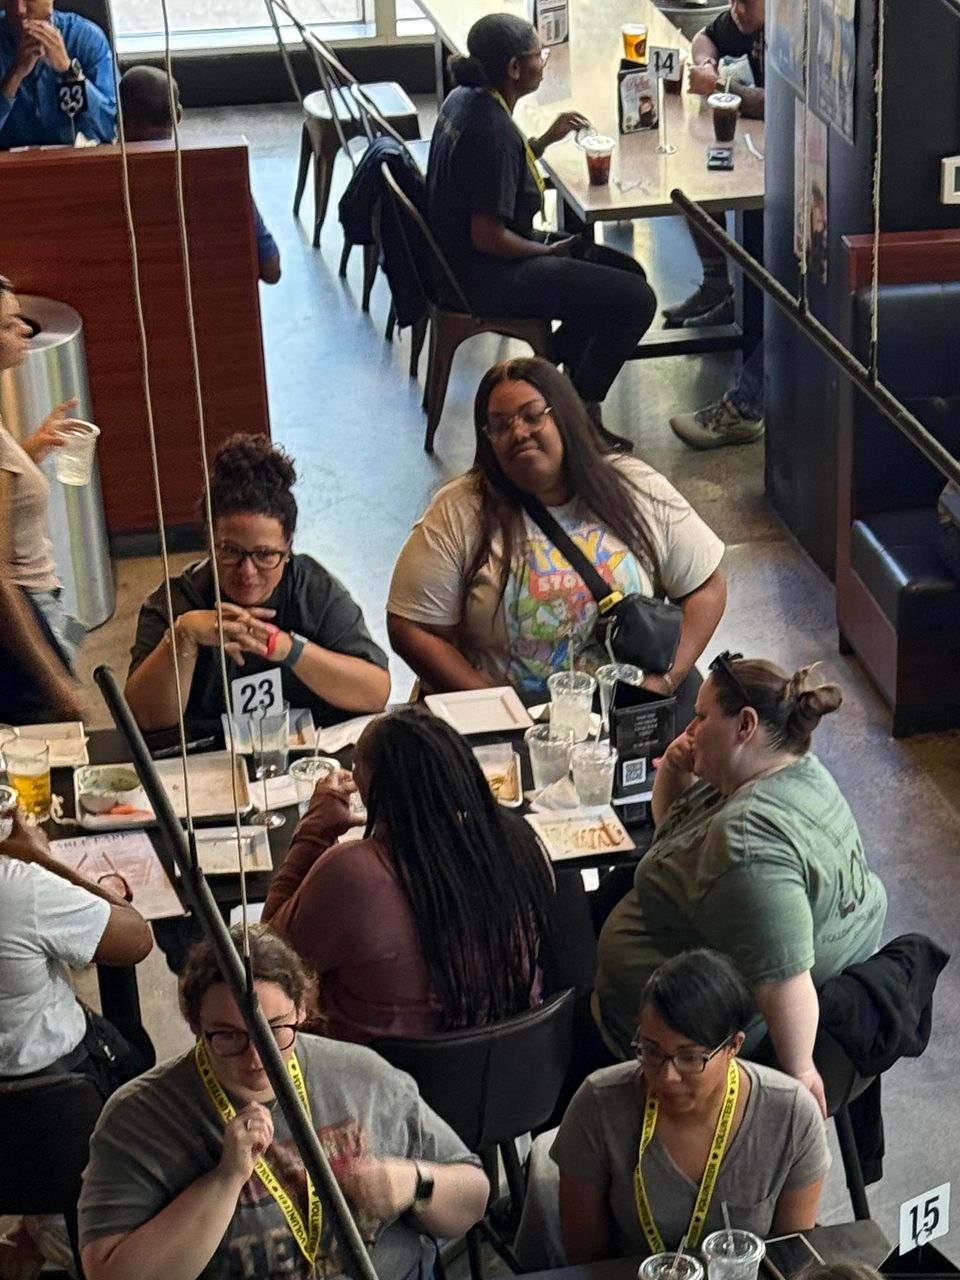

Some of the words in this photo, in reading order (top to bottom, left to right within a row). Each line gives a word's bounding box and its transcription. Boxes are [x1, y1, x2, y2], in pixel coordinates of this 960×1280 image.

[653, 50, 675, 73] 14
[60, 84, 84, 111] 33
[240, 678, 275, 714] 23
[909, 1195, 940, 1241] 15
